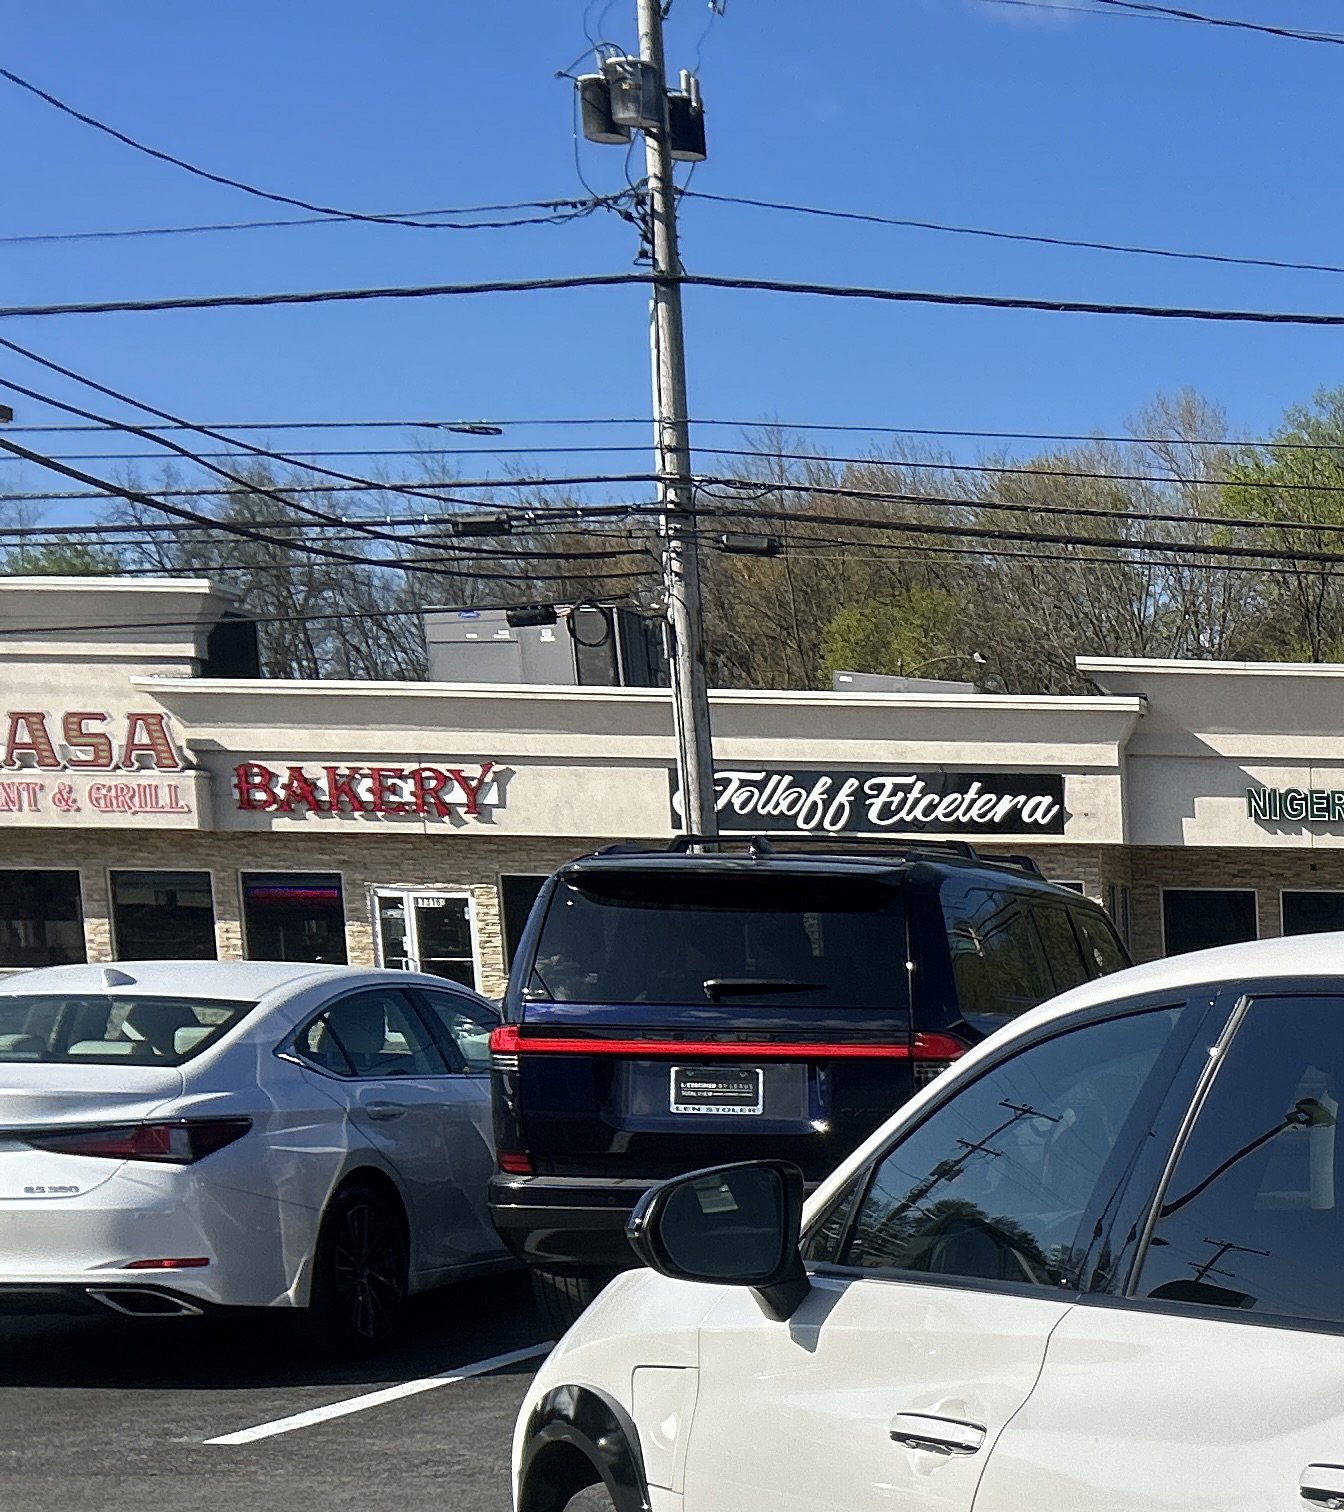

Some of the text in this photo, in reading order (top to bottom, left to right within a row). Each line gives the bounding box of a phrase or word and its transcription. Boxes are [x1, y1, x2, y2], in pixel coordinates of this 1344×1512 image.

[52, 782, 81, 812] &
[88, 782, 193, 814] GRILL
[233, 761, 497, 818] BAKERY
[863, 774, 1061, 826] Etcetera
